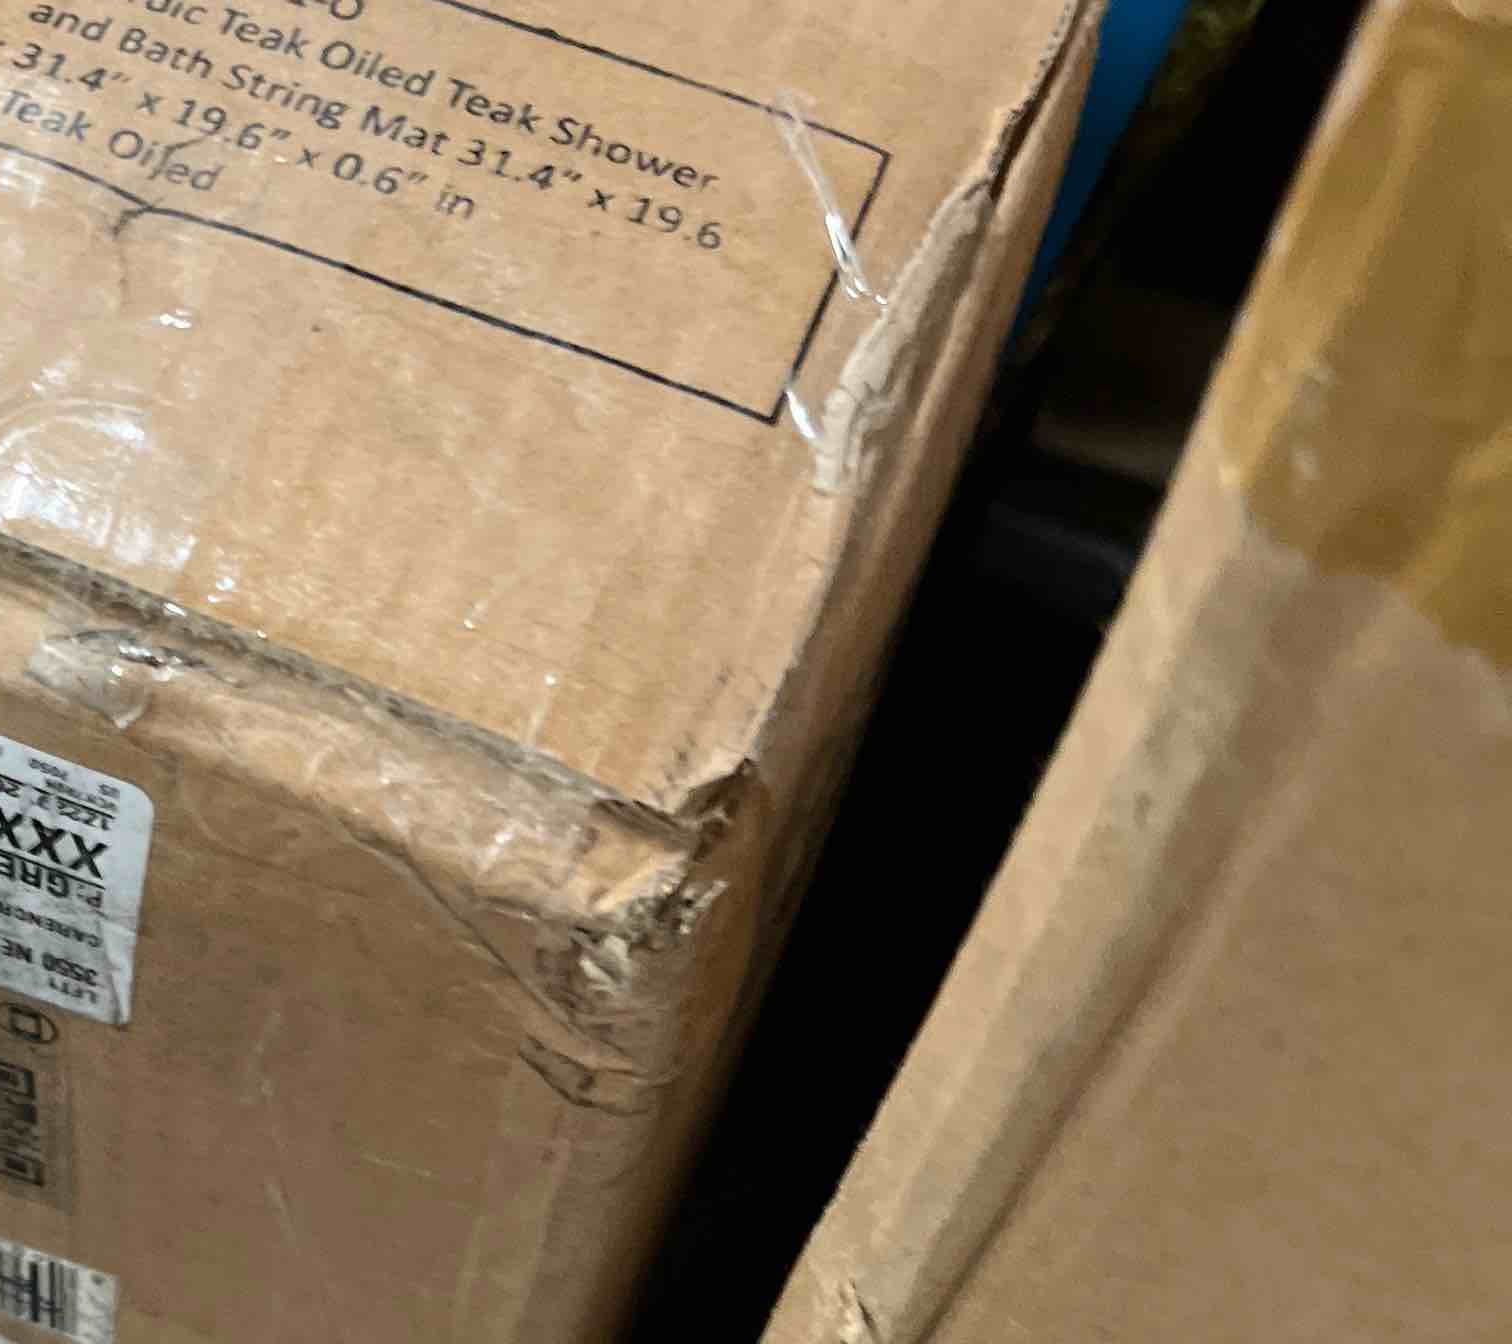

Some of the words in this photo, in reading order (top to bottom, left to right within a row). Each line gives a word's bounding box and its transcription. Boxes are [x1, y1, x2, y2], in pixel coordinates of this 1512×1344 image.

[0, 88, 90, 144] Teak
[28, 0, 114, 43] and
[118, 27, 214, 80] Bath
[221, 60, 350, 131] String
[360, 105, 450, 158] Mat
[628, 194, 724, 252] 19.6
[219, 7, 310, 61] Teak
[321, 35, 437, 99] Oiled
[447, 77, 539, 136] Teak
[547, 115, 721, 194] Shower
[434, 180, 478, 223] in
[0, 936, 34, 964] NE
